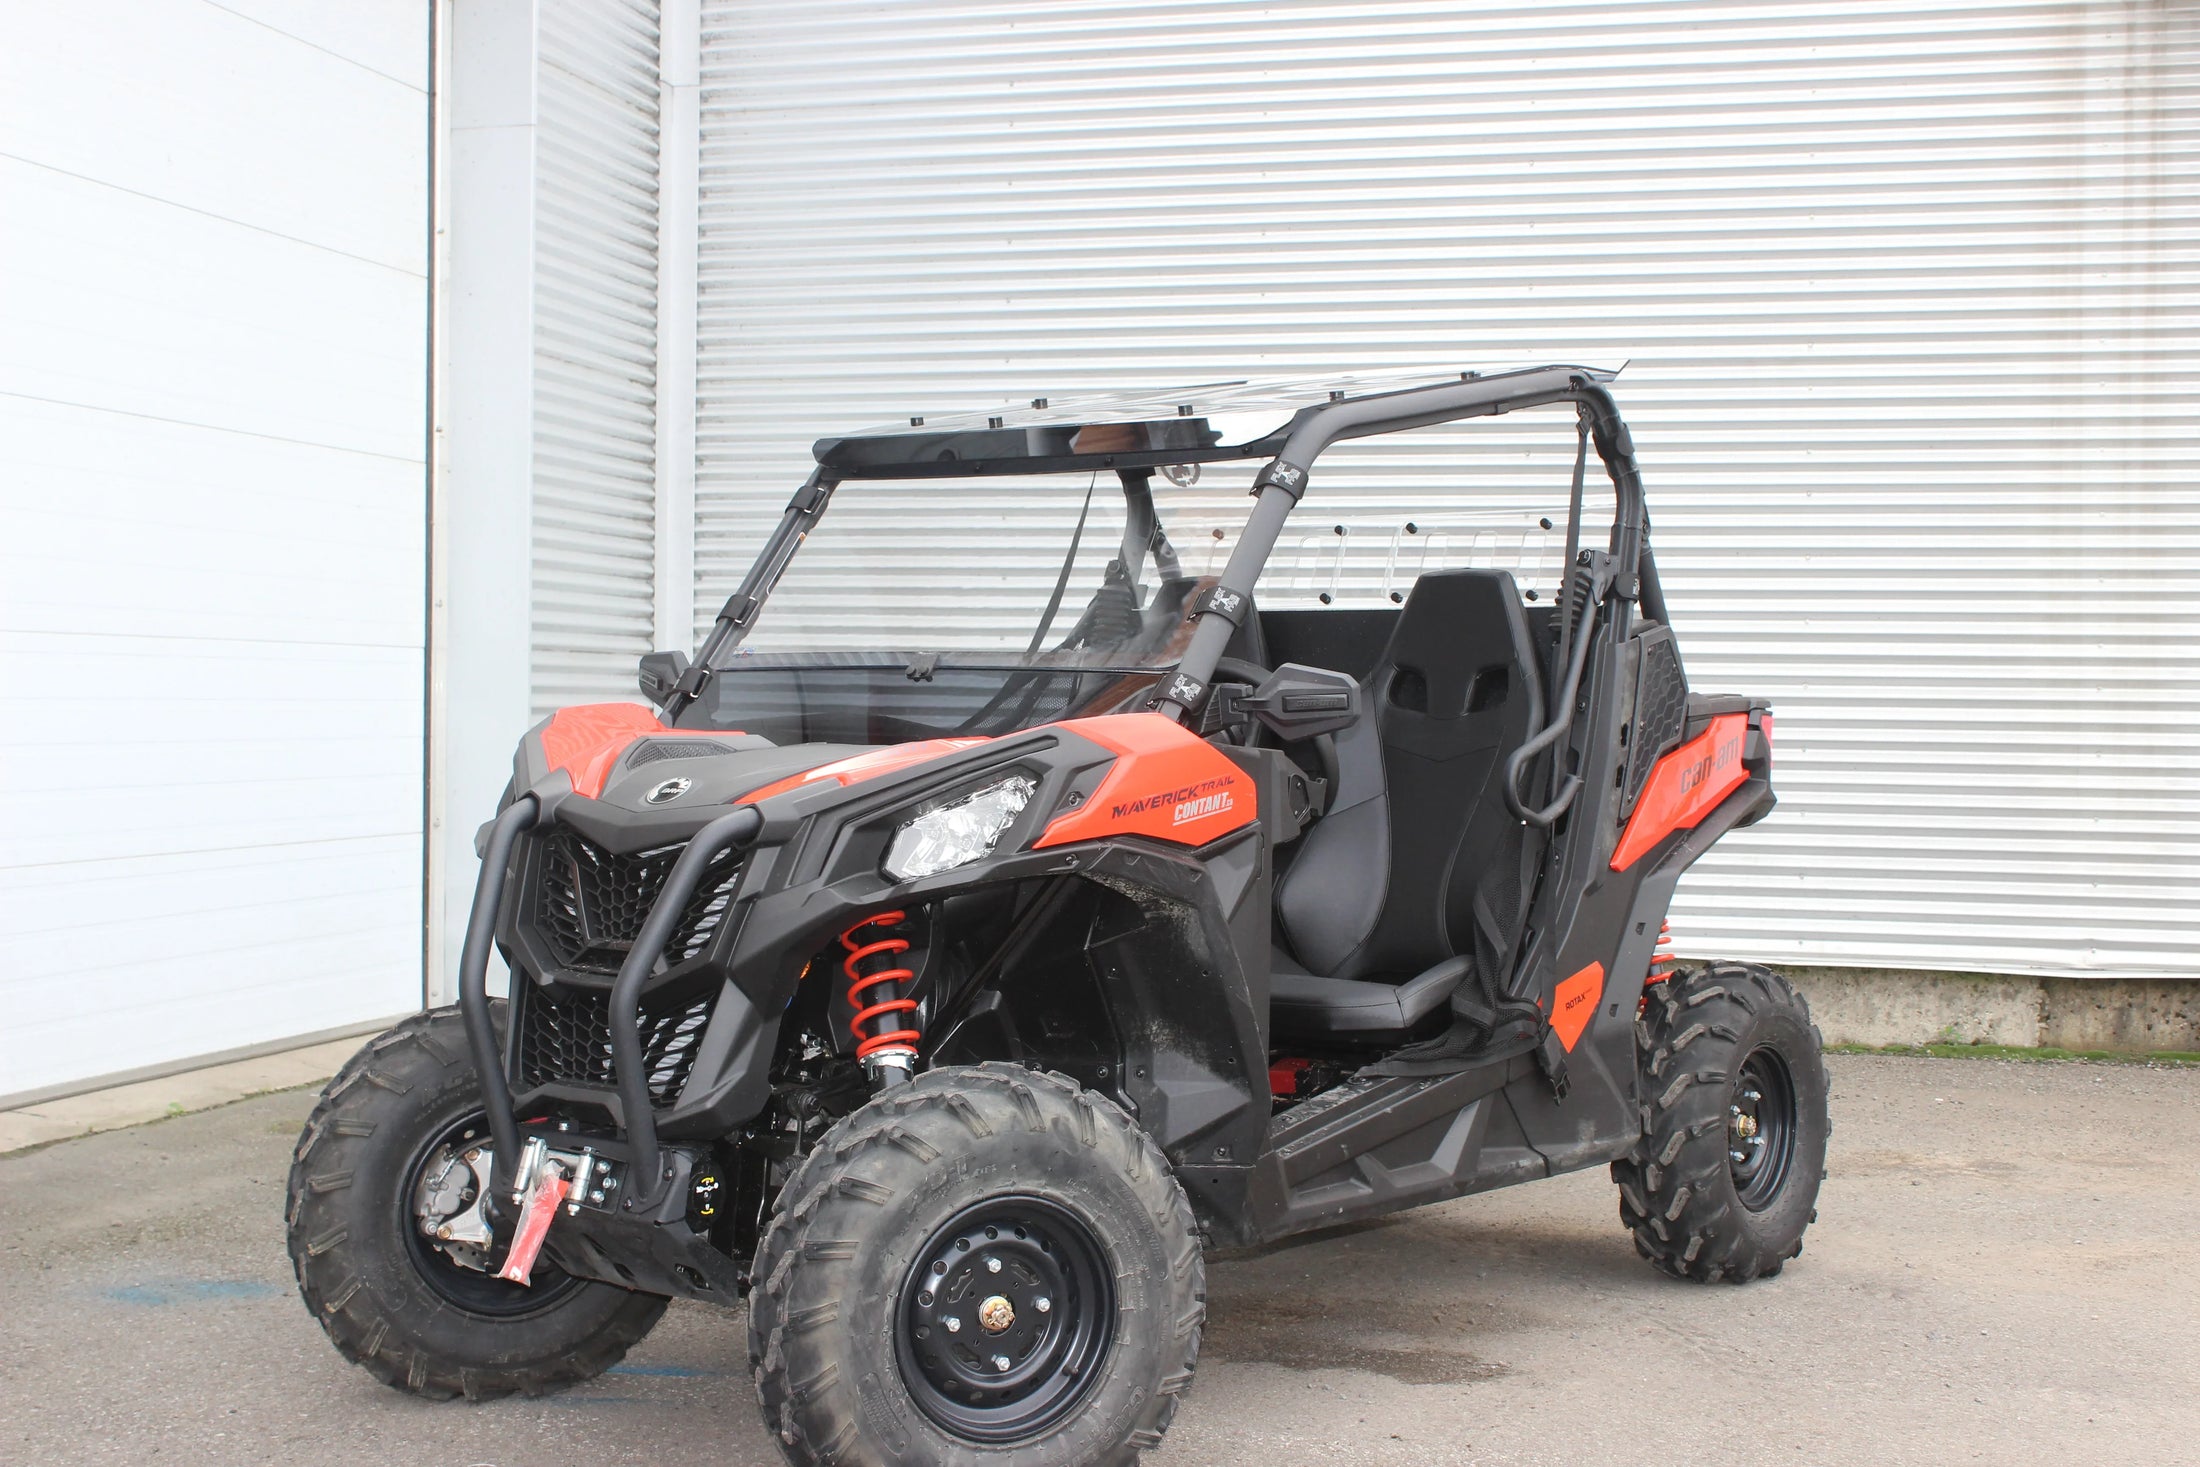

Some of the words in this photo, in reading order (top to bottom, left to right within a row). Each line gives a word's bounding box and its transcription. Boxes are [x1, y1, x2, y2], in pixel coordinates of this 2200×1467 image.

[1111, 784, 1199, 820] MAVERICK
[1201, 775, 1235, 793] TRAIL
[1565, 991, 1586, 1012] ROTAX
